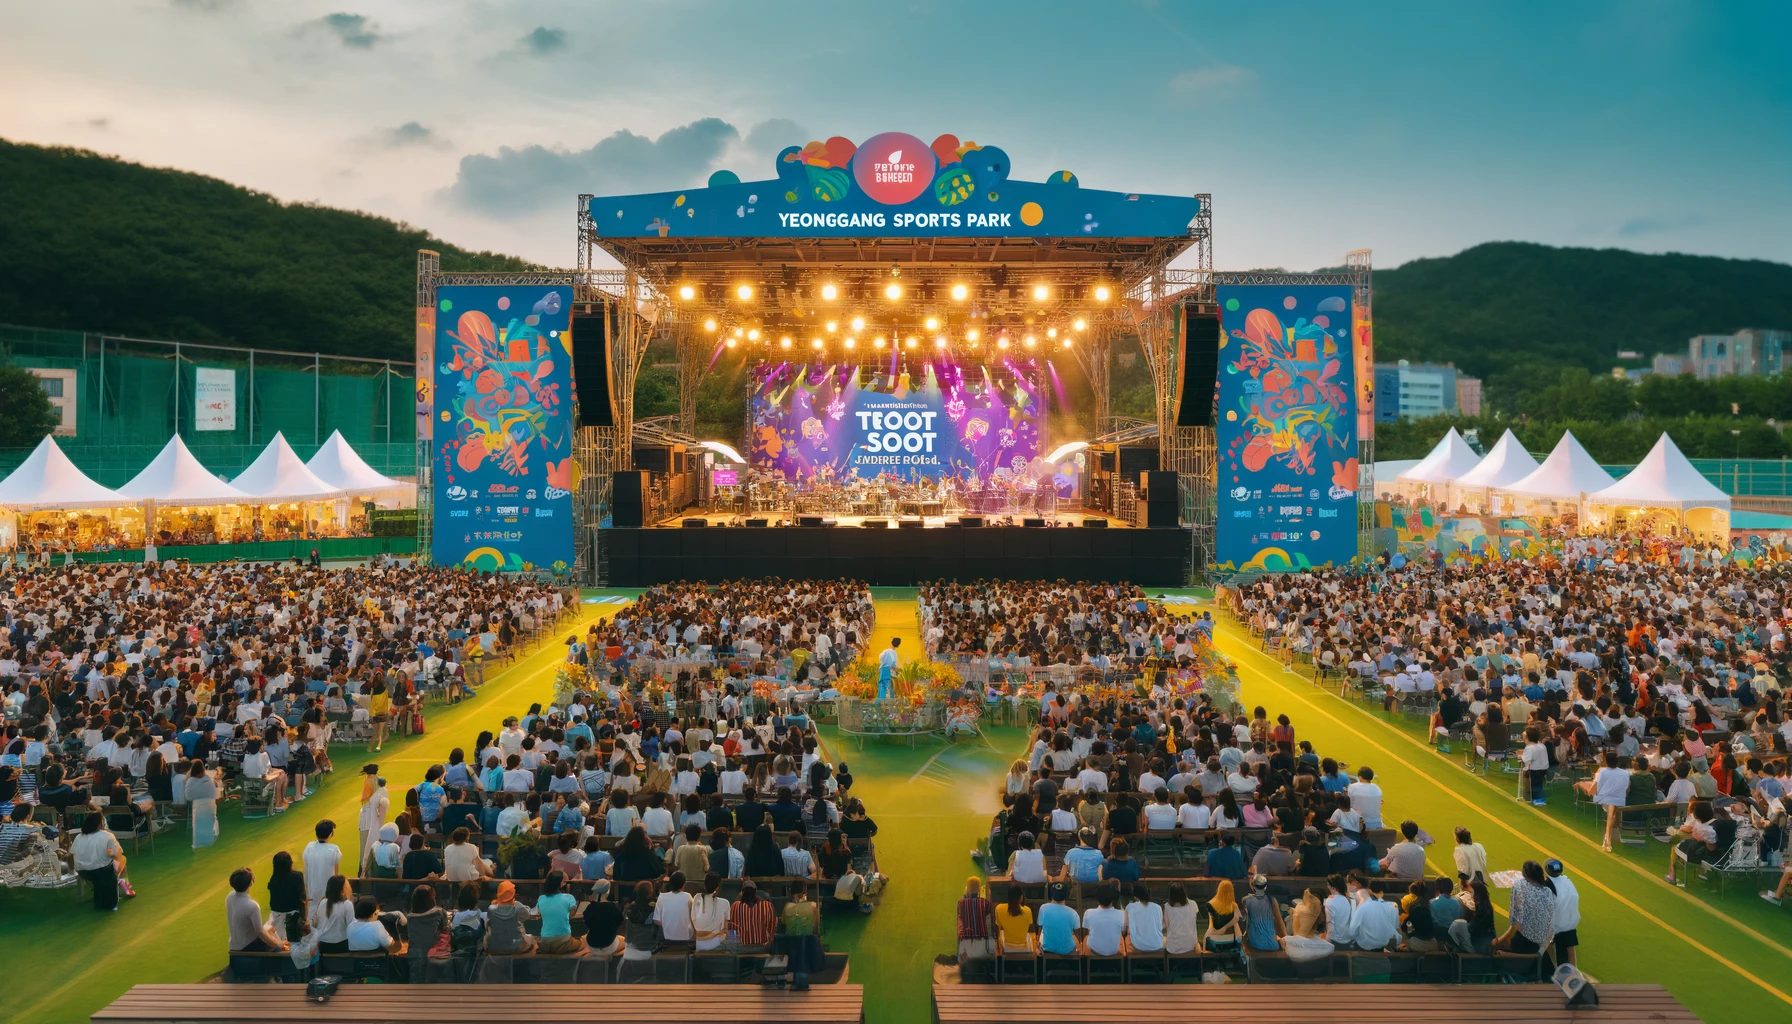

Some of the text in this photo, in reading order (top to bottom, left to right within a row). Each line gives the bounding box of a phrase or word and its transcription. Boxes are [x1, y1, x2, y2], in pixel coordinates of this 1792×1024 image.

[778, 212, 1011, 228] YEONGGANG SPORTS PARK
[867, 432, 937, 453] SOOT
